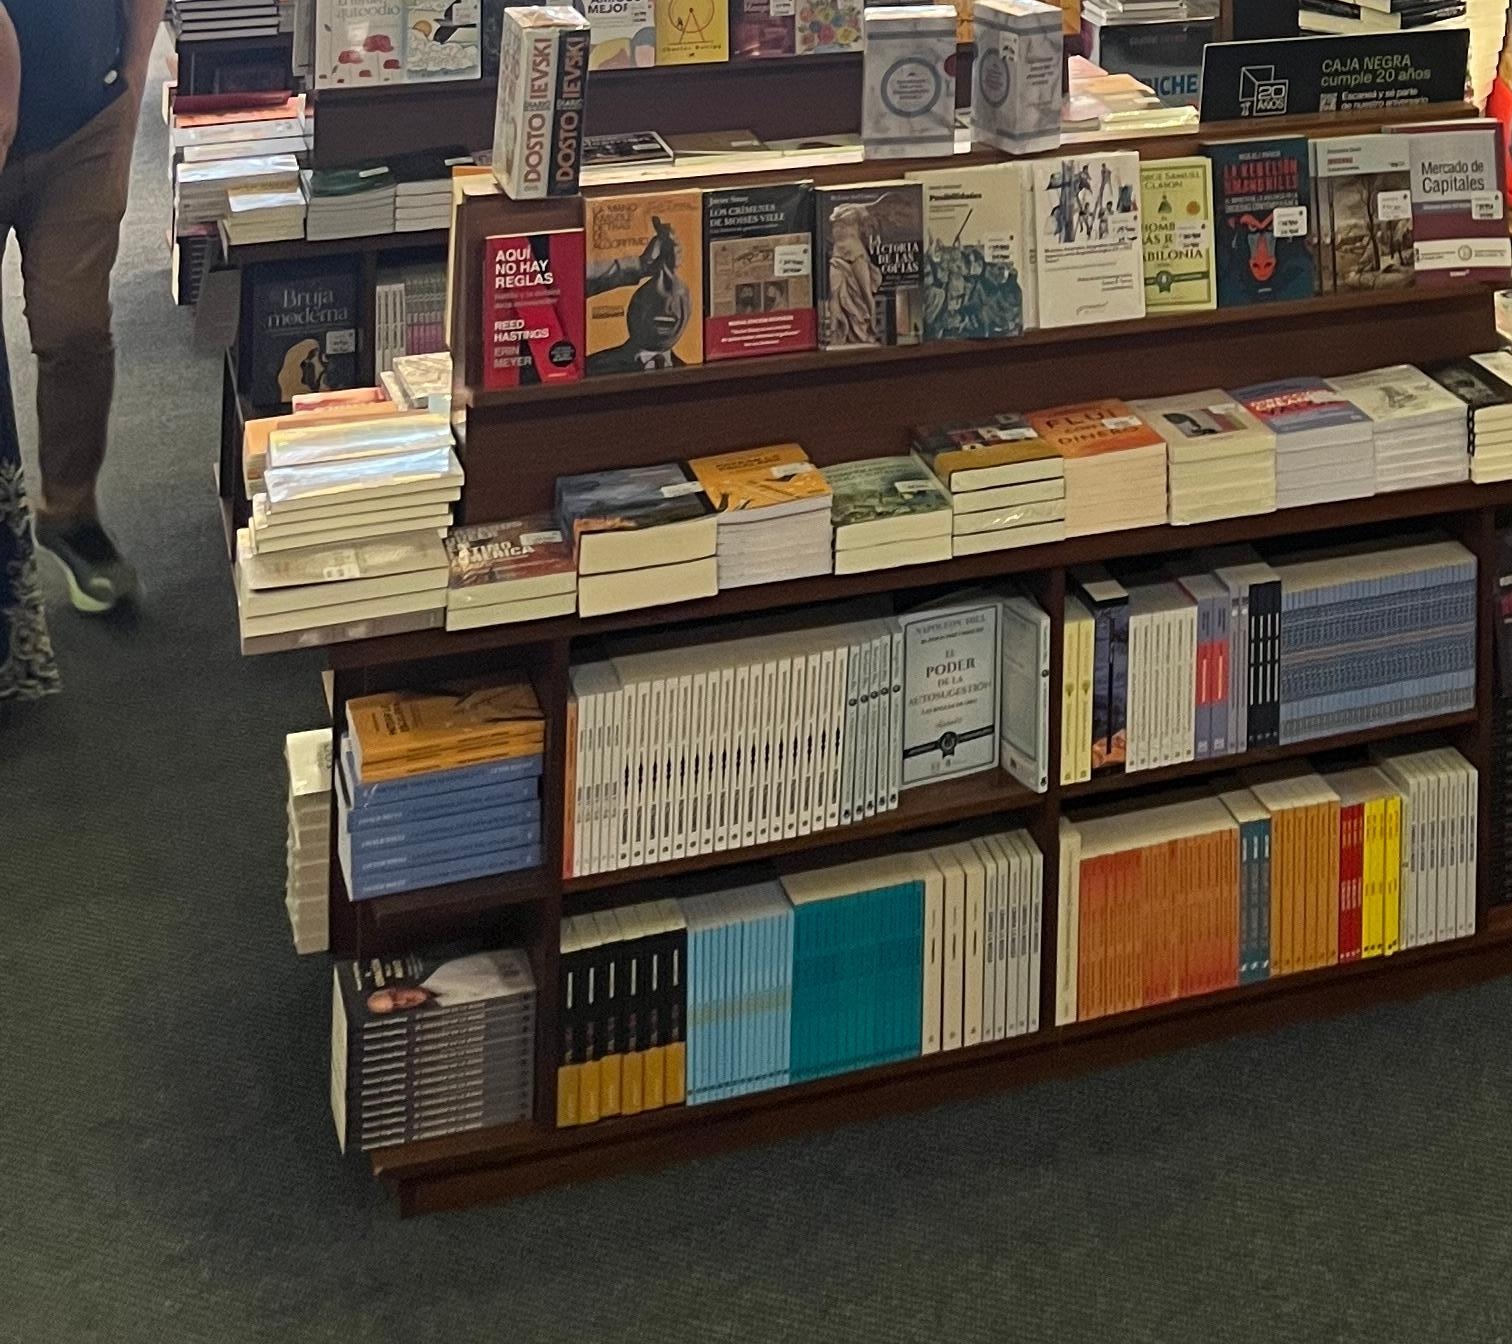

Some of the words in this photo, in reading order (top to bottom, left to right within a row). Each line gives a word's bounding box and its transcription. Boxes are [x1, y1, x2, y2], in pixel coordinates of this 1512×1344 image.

[530, 37, 551, 100] IEVSKI
[562, 37, 586, 100] IEVSKI
[1322, 57, 1360, 73] CAJA
[1363, 54, 1412, 70] NEGRA
[1321, 71, 1372, 88] cumple
[1375, 69, 1395, 83] 20
[1397, 67, 1431, 81] años
[1258, 85, 1287, 99] 20
[524, 113, 546, 183] DOSTO
[556, 111, 579, 182] DOSTO
[1421, 161, 1469, 175] Mercado
[1470, 160, 1484, 173] de
[1422, 176, 1485, 194] Capitales
[496, 243, 531, 262] AQUÍ
[869, 242, 920, 255] VICTORIA
[877, 253, 891, 264] DE
[894, 252, 916, 263] LAS
[495, 262, 517, 275] NO
[520, 259, 549, 273] HAY
[881, 261, 920, 274] COPIAS
[495, 272, 554, 289] REGLAS
[283, 288, 335, 309] Bruja
[267, 306, 348, 328] moderna
[494, 319, 525, 331] REED
[494, 328, 550, 343] HASTINGS
[494, 355, 532, 369] MEYER
[926, 657, 976, 679] PODER
[937, 678, 950, 689] DE
[952, 675, 963, 686] LA
